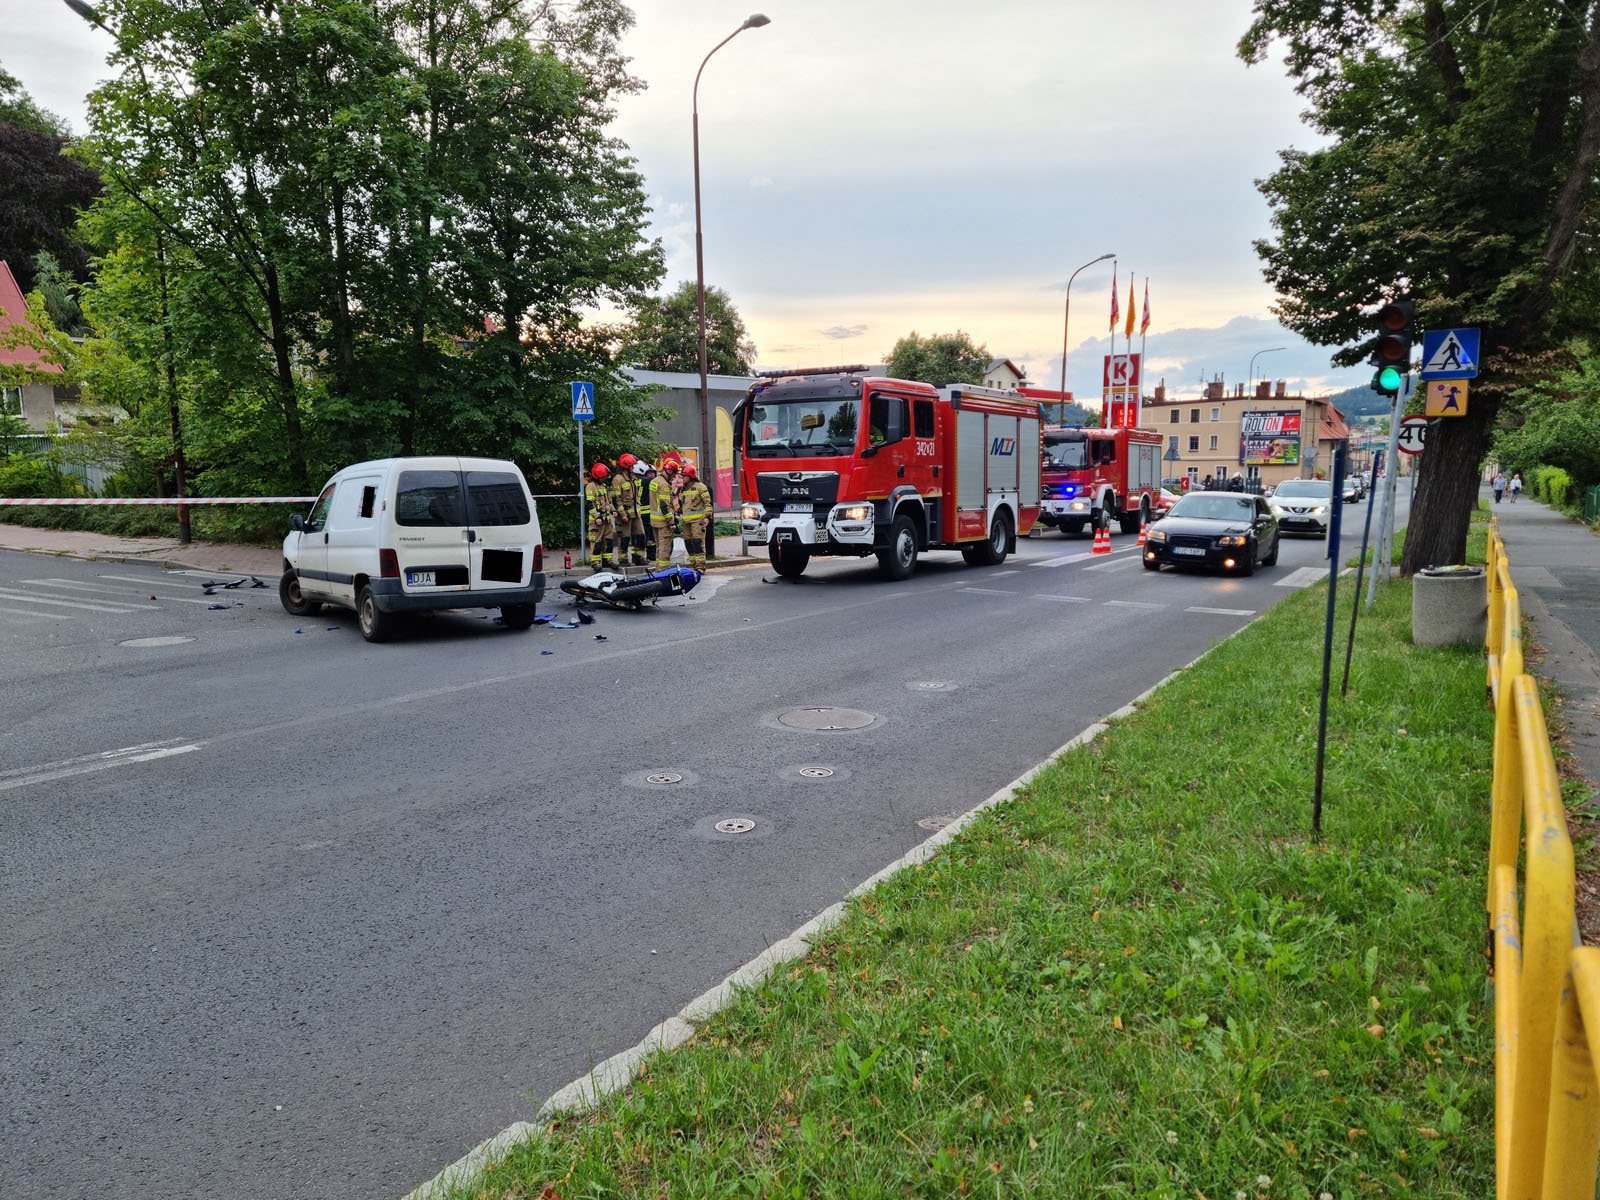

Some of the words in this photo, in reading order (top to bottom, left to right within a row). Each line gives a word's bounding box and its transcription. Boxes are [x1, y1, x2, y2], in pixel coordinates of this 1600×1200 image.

[1114, 363, 1127, 379] K
[781, 487, 810, 495] MAN
[413, 573, 432, 583] DJA
